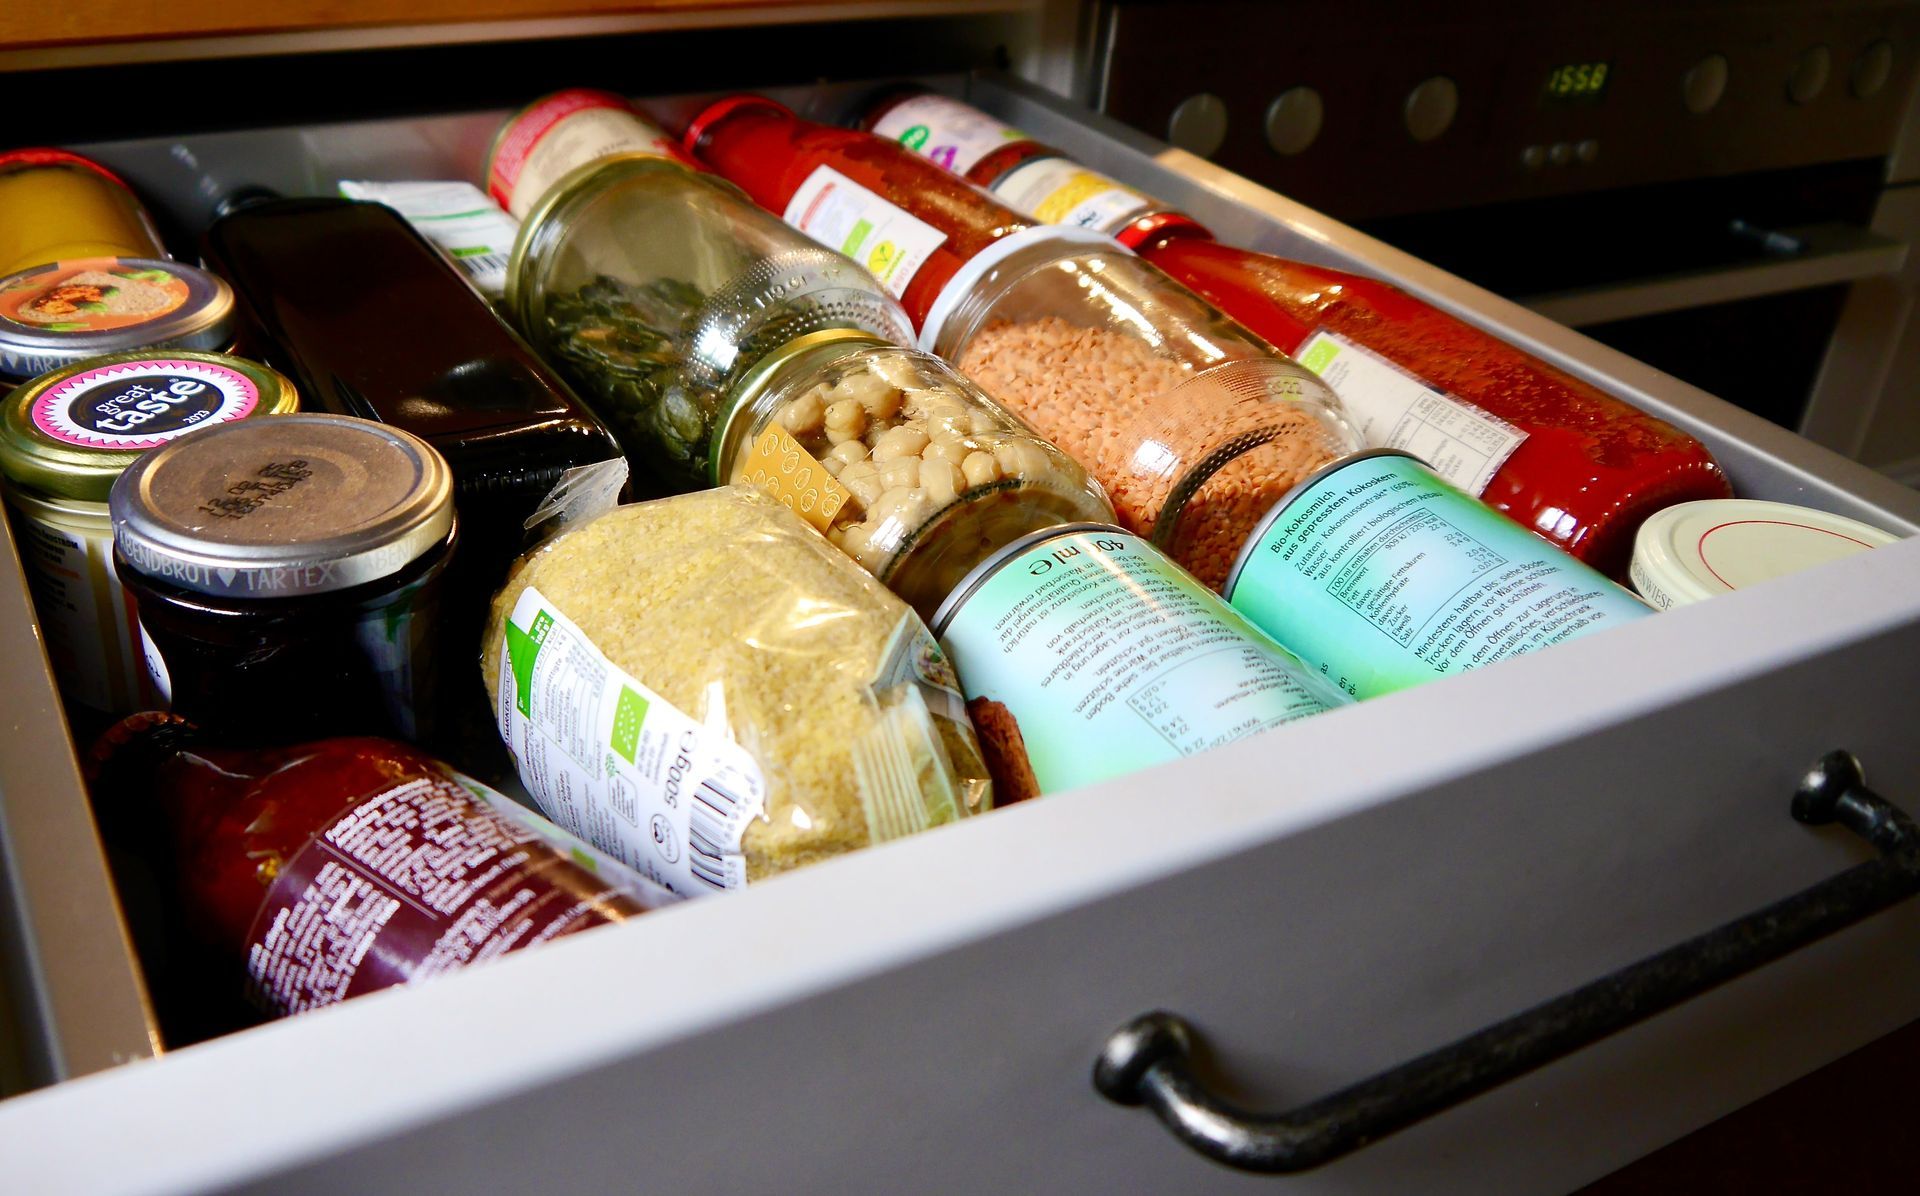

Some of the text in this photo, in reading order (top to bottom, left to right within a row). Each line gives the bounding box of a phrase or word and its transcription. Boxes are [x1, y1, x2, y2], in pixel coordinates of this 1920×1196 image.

[94, 379, 206, 432] taste
[95, 384, 154, 415] great
[1270, 489, 1336, 555] Bio-Kokosmilch
[1282, 472, 1398, 561] aus gepresstem Kokoskern
[1331, 525, 1372, 564] kontrolliert
[1369, 496, 1419, 528] biologischem
[119, 530, 213, 587] ABENDBROT
[239, 562, 341, 592] TARTEX
[1051, 545, 1081, 564] ml
[1294, 540, 1323, 571] Zutaten:
[1303, 548, 1329, 577] Wasser
[1331, 511, 1429, 592] 100 ml enthalten durchschnittlich:
[1339, 566, 1369, 599] Brennwert
[1384, 539, 1400, 550] 909
[1410, 522, 1425, 534] 220
[1346, 589, 1361, 604] Fett
[1428, 522, 1440, 532] 22
[1366, 579, 1394, 611] gesättigte
[1392, 552, 1427, 581] Fettsäuren
[1444, 532, 1456, 541] 22
[993, 562, 1095, 632] im Wasserbad erwärmen.
[1012, 579, 1081, 628] Qualitätsmangel
[1050, 581, 1098, 610] Konsistenz
[1354, 587, 1375, 610] davon:
[1368, 576, 1410, 620] Kohlenhydrate
[1037, 609, 1049, 621] ist
[1046, 598, 1124, 650] und innerhalb von
[1133, 616, 1166, 630] Öffnen
[1377, 604, 1397, 626] davon:
[1388, 604, 1409, 627] Zucker
[1391, 615, 1412, 637] Eiweiß
[1414, 613, 1458, 659] Mindestens
[1454, 590, 1486, 617] haltbar
[1499, 567, 1522, 584] siehe
[1424, 634, 1456, 667] Trocken
[1455, 606, 1485, 635] lagern,
[1483, 595, 1497, 608] vor
[1493, 578, 1526, 598] Wärme
[1434, 658, 1451, 674] Vor
[1450, 640, 1469, 661] dem
[1464, 613, 1494, 640] Öffnen
[1492, 603, 1509, 618] gut
[1508, 581, 1548, 606] schütteln.
[1473, 647, 1488, 664] dem
[1487, 620, 1518, 647] Öffnen
[1516, 609, 1531, 622] zur
[1529, 588, 1571, 613] Lagerung
[1532, 604, 1594, 643] im Kühlschrank
[1551, 611, 1606, 644] innerhalb von
[997, 627, 1012, 643] dar.
[1003, 619, 1037, 655] natürlich
[1055, 608, 1122, 657] im Kühlschrank
[1116, 629, 1131, 639] zur
[1138, 635, 1153, 647] gut
[1155, 624, 1187, 639] Öffnen
[1400, 627, 1415, 643] Salz
[1039, 628, 1105, 689] verschließbares
[1071, 638, 1115, 672] Lagerung
[1093, 646, 1137, 677] schütteln.
[1113, 654, 1146, 677] Wärme
[1147, 645, 1161, 654] vor
[1063, 670, 1073, 681] in
[1114, 673, 1139, 694] siehe
[1072, 677, 1112, 714] schützen.
[1085, 693, 1115, 721] Boden
[664, 755, 692, 809] 500g
